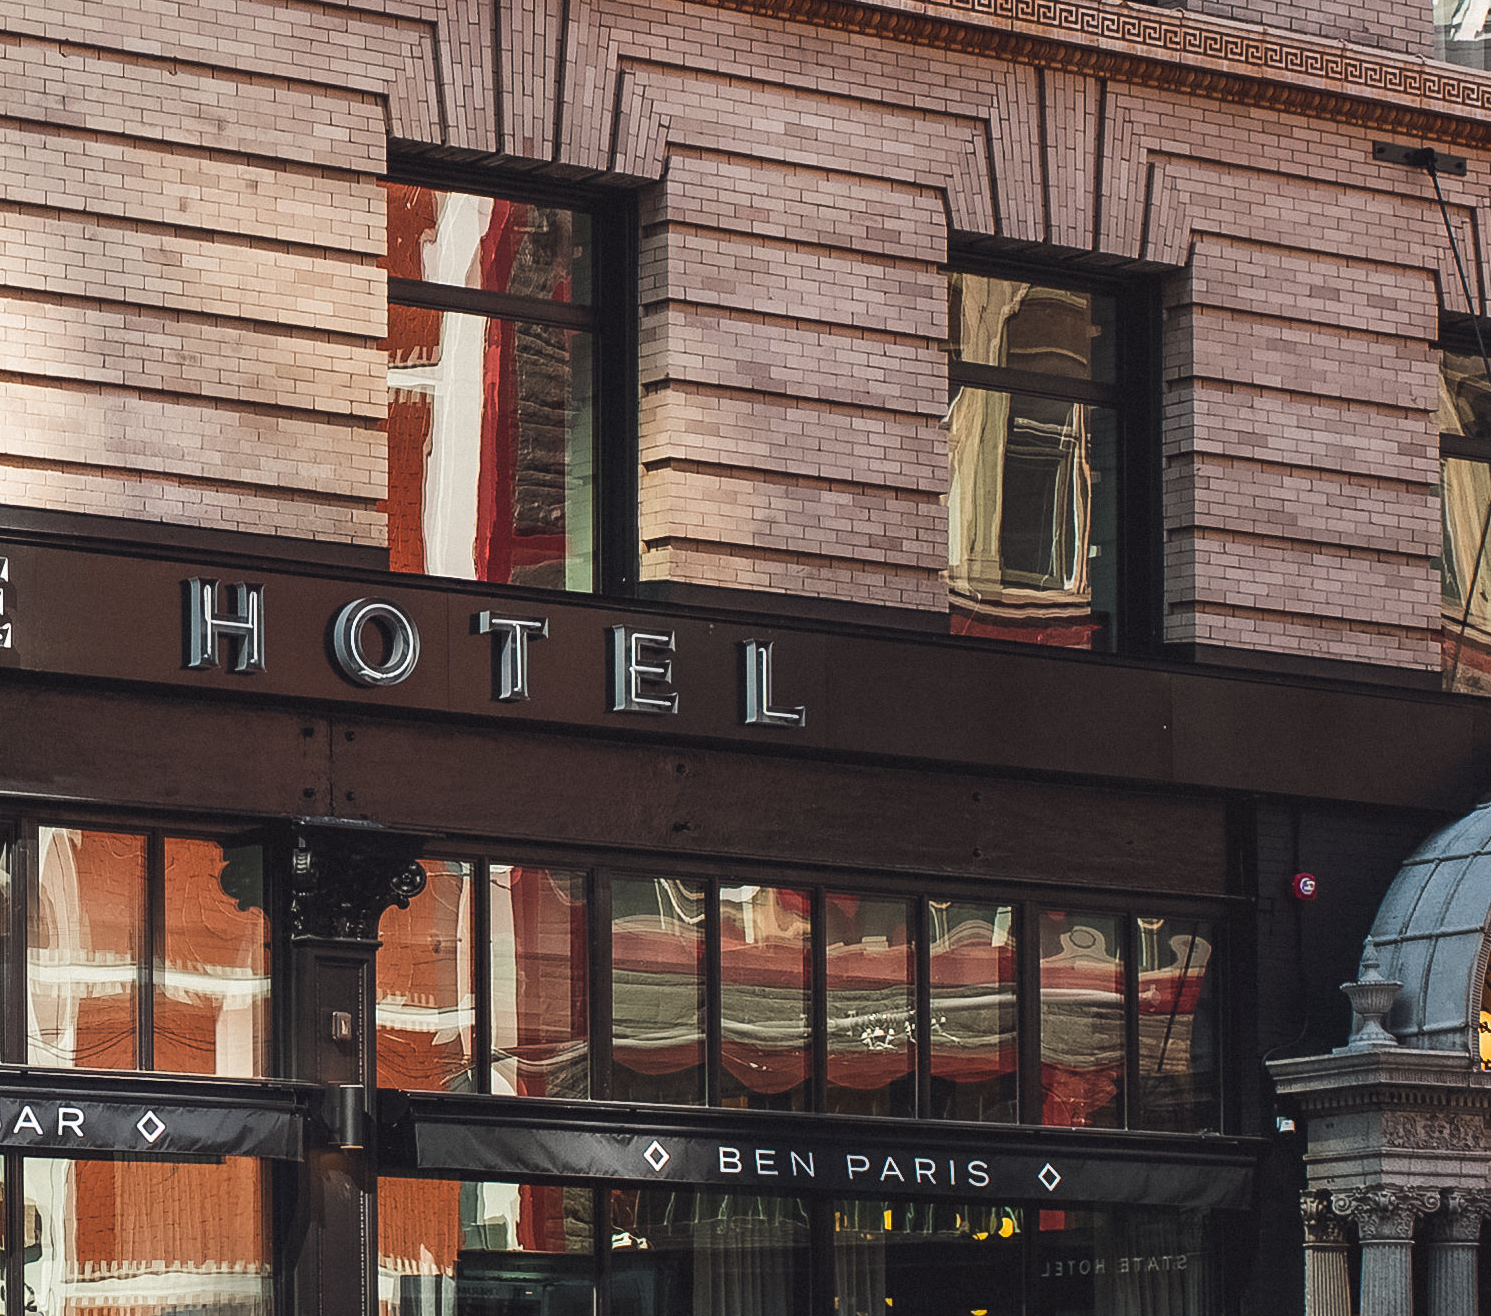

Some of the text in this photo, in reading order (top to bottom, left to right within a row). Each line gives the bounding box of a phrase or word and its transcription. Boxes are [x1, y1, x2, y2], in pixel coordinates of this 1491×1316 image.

[186, 576, 807, 728] HOTEL
[718, 1145, 992, 1189] BEN PARIS
